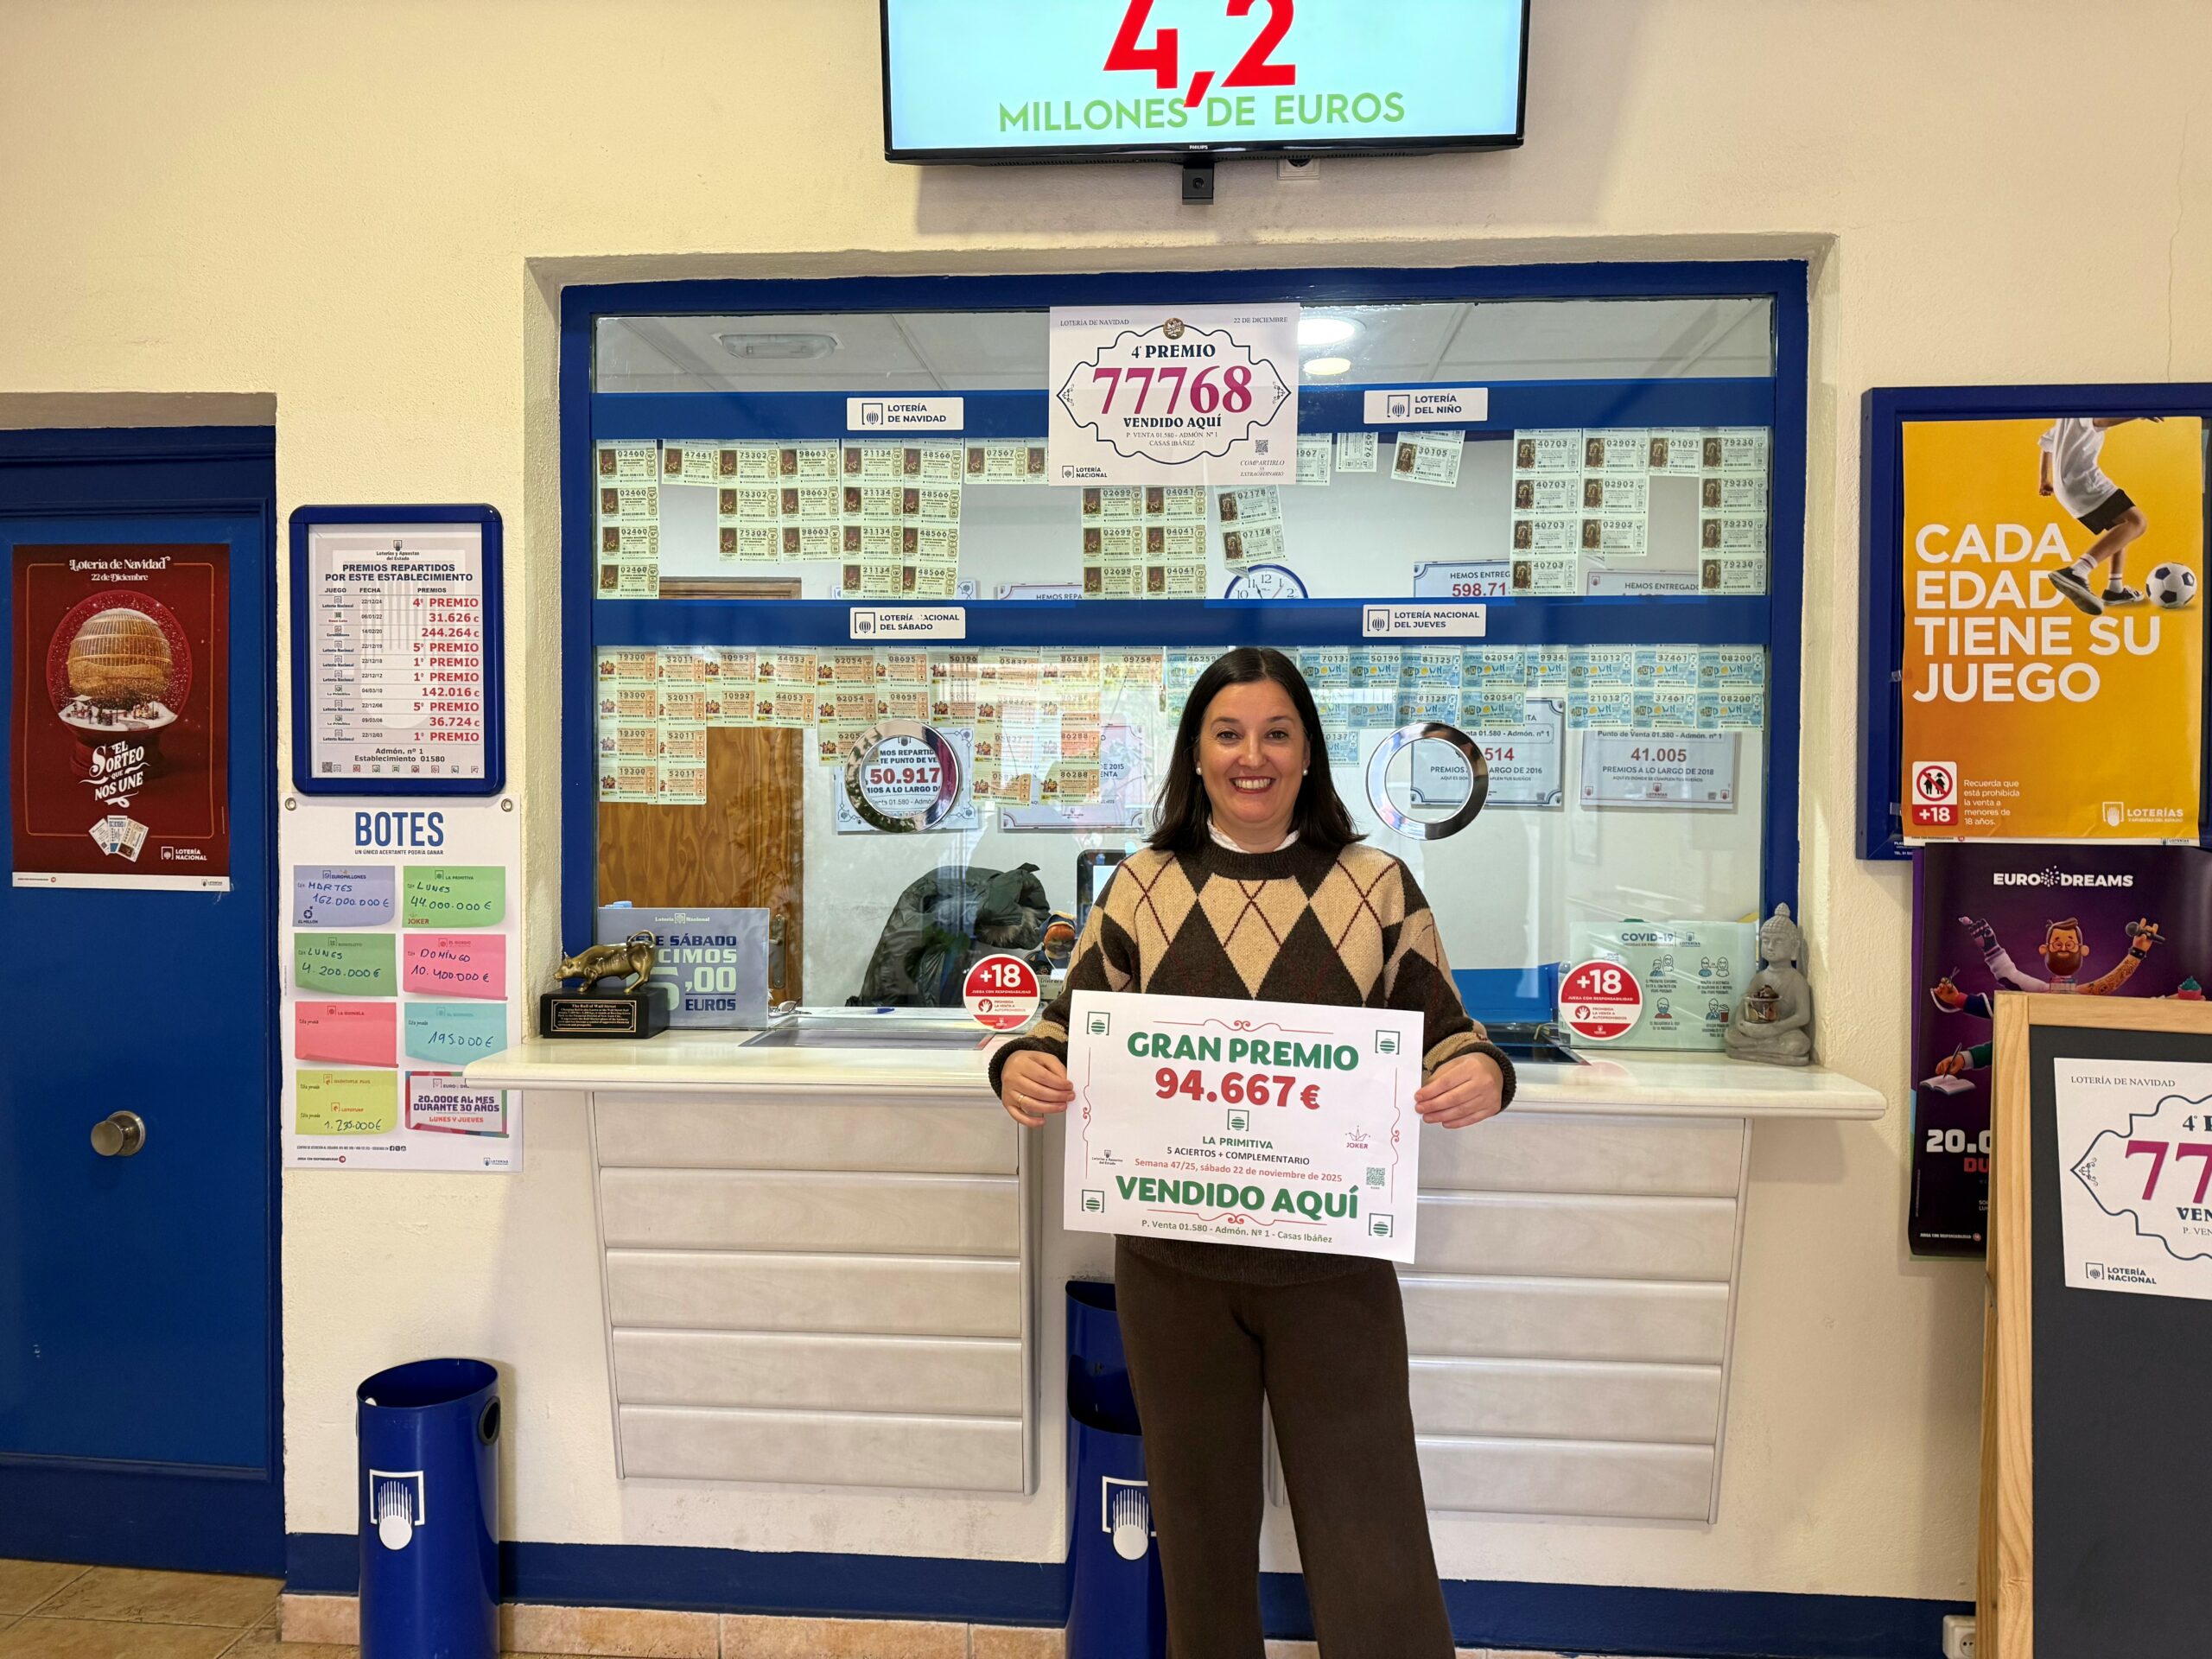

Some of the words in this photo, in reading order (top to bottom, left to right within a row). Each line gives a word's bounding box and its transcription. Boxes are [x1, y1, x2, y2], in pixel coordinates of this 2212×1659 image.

[1103, 0, 1296, 107] 4,2
[999, 98, 1190, 132] MILLONES
[1208, 95, 1254, 127] DE
[1274, 91, 1406, 125] EUROS
[1145, 344, 1216, 359] PREMIO
[1092, 365, 1252, 415] 77768
[1414, 393, 1457, 404] LOTERÍA
[887, 403, 927, 412] LOTERÍA
[1414, 406, 1434, 415] DEL
[1436, 404, 1462, 414] NIÑO
[1123, 417, 1184, 428] VENDIDO
[1186, 414, 1221, 429] AQUÍ
[1537, 439, 1568, 448] 40703
[1606, 439, 1637, 448] 02902
[740, 450, 767, 459] 75302
[799, 449, 827, 458] 98663
[864, 449, 892, 458] 21134
[924, 450, 950, 459] 48566
[1915, 523, 2073, 564] CADA
[69, 559, 108, 572] Lotería
[109, 559, 123, 569] de
[124, 556, 171, 569] Navidad
[391, 563, 455, 572] REPARTIDOS
[91, 573, 100, 582] 22
[100, 573, 110, 582] de
[111, 573, 149, 582] Diciembre
[378, 573, 474, 582] ESTABLECIMIENTO
[1916, 569, 2067, 610] EDAD
[429, 598, 480, 608] PREMIO
[429, 613, 472, 623] 31.626
[880, 613, 914, 622] LOTERÍA
[1394, 609, 1432, 619] LOTERÍA
[898, 621, 933, 631] SÁBADO
[1394, 620, 1411, 629] DEL
[422, 627, 472, 638] 244.264
[1914, 616, 2073, 657] TIENE
[2088, 615, 2160, 657] SU
[429, 643, 480, 652] PREMIO
[1912, 662, 2101, 703] JUEGO
[423, 687, 472, 697] 142.016
[429, 716, 472, 727] 36.724
[114, 740, 129, 754] EL
[89, 743, 145, 777] SORTEO
[1630, 747, 1688, 762] 41.005
[111, 770, 124, 779] QUE
[1602, 765, 1637, 773] PREMIOS
[870, 766, 940, 785] 50.917
[94, 784, 118, 801] NOS
[118, 771, 143, 793] UNE
[1963, 779, 2001, 788] Recuerda
[2003, 780, 2019, 789] que
[1982, 788, 2020, 797] prohibida
[1919, 807, 1951, 823] +18
[2127, 807, 2184, 817] LOTERÍAS
[354, 811, 444, 847] BOTES
[175, 847, 201, 855] LOTERÍA
[308, 882, 353, 893] MARTES
[416, 880, 450, 893] LUNES
[670, 932, 737, 946] SÁBADO
[1621, 932, 1674, 942] COVID-19
[308, 947, 343, 960] LUNES
[980, 963, 1021, 988] +18
[1576, 969, 1623, 995] +18
[685, 999, 736, 1011] EUROS
[1127, 1031, 1221, 1063] GRAN
[1229, 1037, 1359, 1071] PREMIO
[2070, 1075, 2112, 1085] LOTERÍA
[2113, 1077, 2127, 1086] DE
[2129, 1078, 2176, 1088] NAVIDAD
[1155, 1066, 1296, 1108] 94.667
[1300, 1084, 1321, 1110] €
[461, 1095, 474, 1103] AL
[475, 1096, 495, 1104] MES
[413, 1103, 458, 1112] DURANTE
[474, 1102, 499, 1112] AÑOS
[1202, 1135, 1217, 1146] LA
[1219, 1136, 1274, 1150] PRIMITIVA
[1174, 1147, 1216, 1159] ACIERTOS
[1225, 1151, 1310, 1166] COMPLEMENTARIO
[1135, 1158, 1169, 1169] Semana
[1170, 1160, 1198, 1173] 47/25,
[1199, 1161, 1231, 1174] sábado
[1233, 1165, 1243, 1174] 22
[1245, 1165, 1256, 1175] de
[1258, 1166, 1306, 1179] noviembre
[1307, 1170, 1319, 1180] de
[1320, 1173, 1343, 1183] 2025
[1116, 1175, 1266, 1211] VENDIDO
[1271, 1185, 1359, 1222] AQUÍ
[1152, 1220, 1178, 1230] Venta
[1178, 1222, 1208, 1233] 01.580
[1215, 1224, 1249, 1236] Admón.
[1277, 1230, 1301, 1241] Casas
[1303, 1230, 1333, 1244] Ibáñez
[2107, 1266, 2146, 1277] LOTERÍA
[2107, 1274, 2158, 1286] NACIONAL
